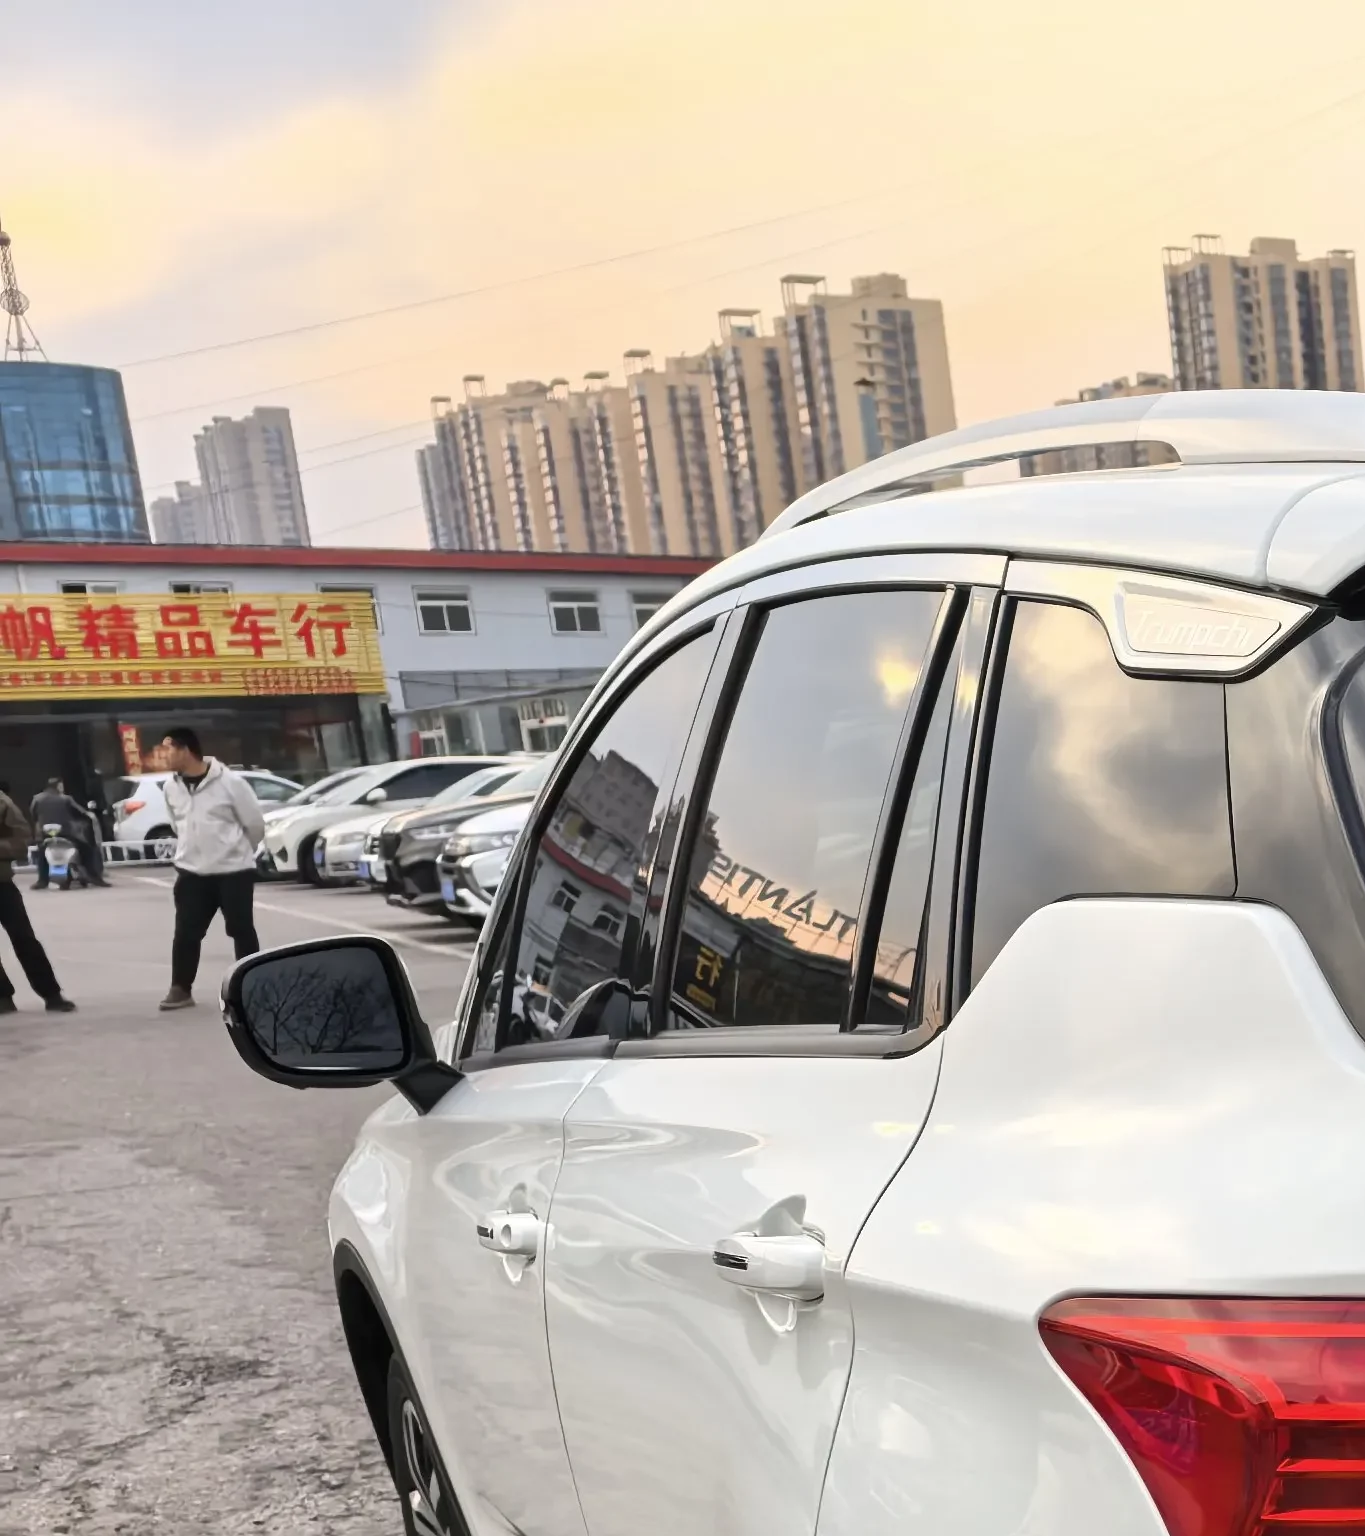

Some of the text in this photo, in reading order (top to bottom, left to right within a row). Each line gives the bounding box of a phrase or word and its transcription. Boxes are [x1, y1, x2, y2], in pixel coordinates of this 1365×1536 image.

[0, 603, 352, 661] 帆精品车行
[1132, 610, 1255, 650] Trumpchi
